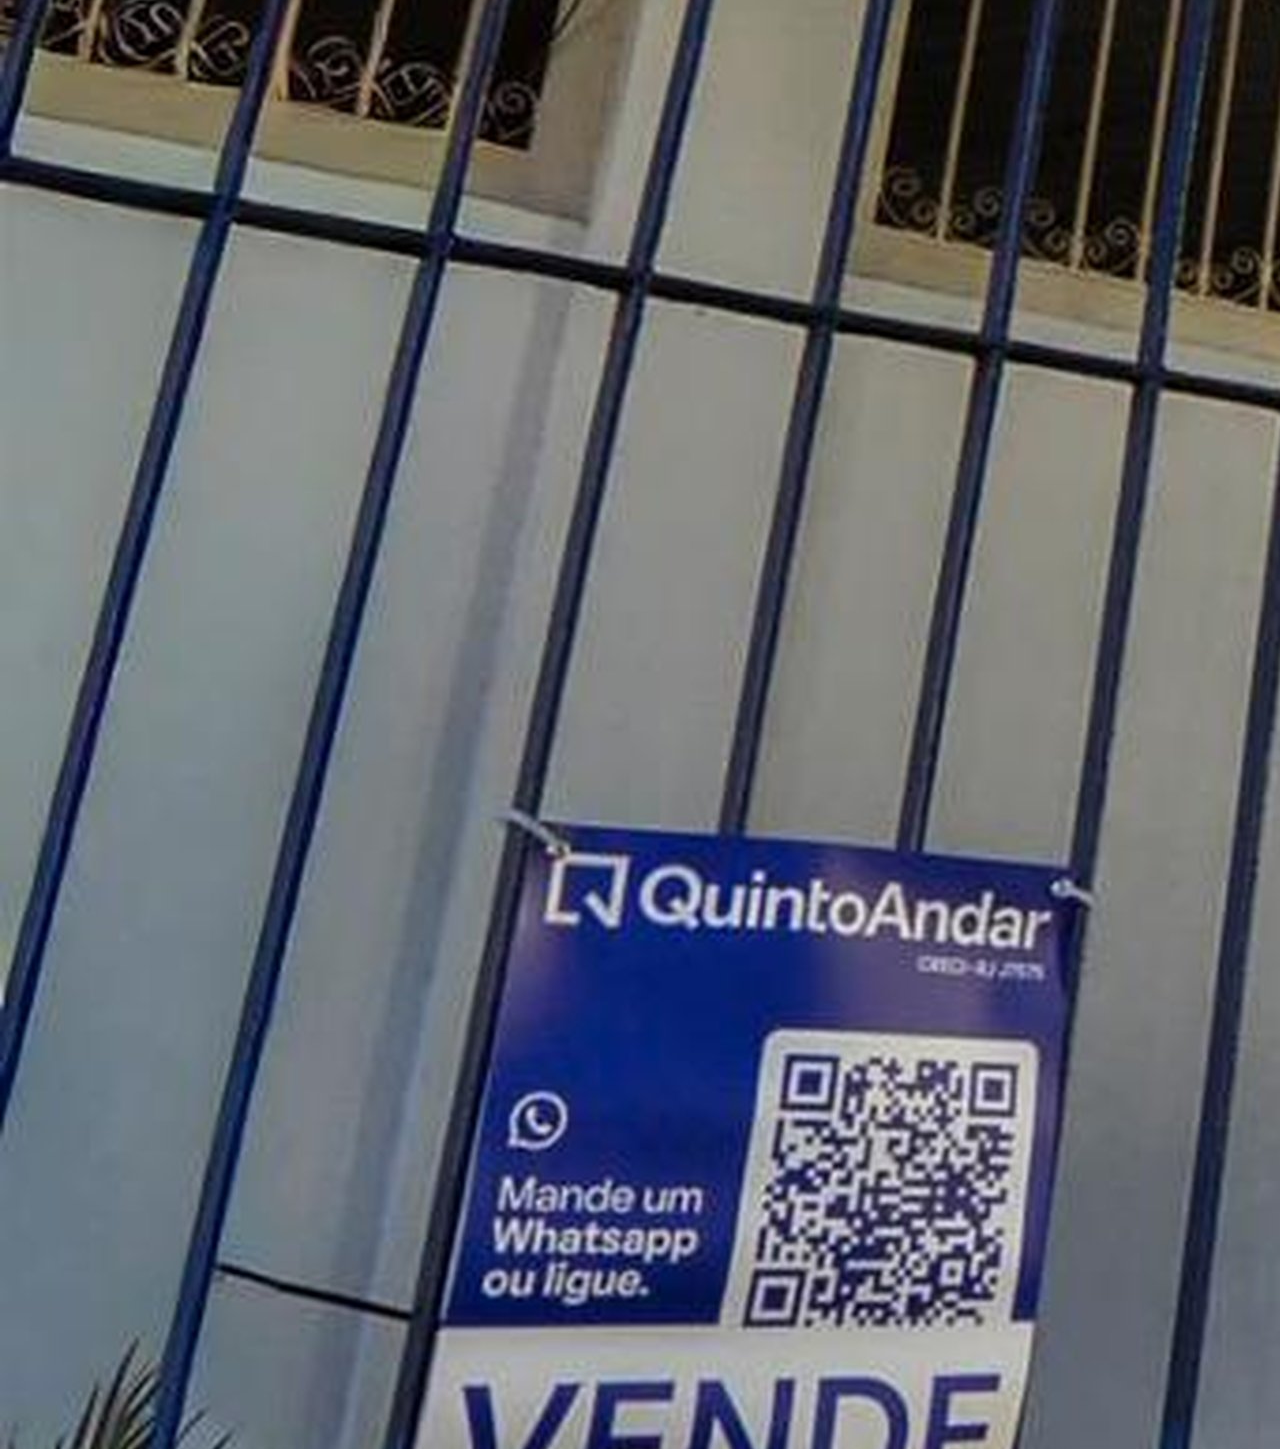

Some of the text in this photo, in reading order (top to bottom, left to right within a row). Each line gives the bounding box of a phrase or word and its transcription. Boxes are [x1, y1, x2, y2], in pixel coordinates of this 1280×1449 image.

[638, 864, 1052, 950] QuintoAndar
[498, 1175, 704, 1214] Mande um
[493, 1217, 699, 1263] Whatsapp
[481, 1261, 650, 1305] ou ligue.
